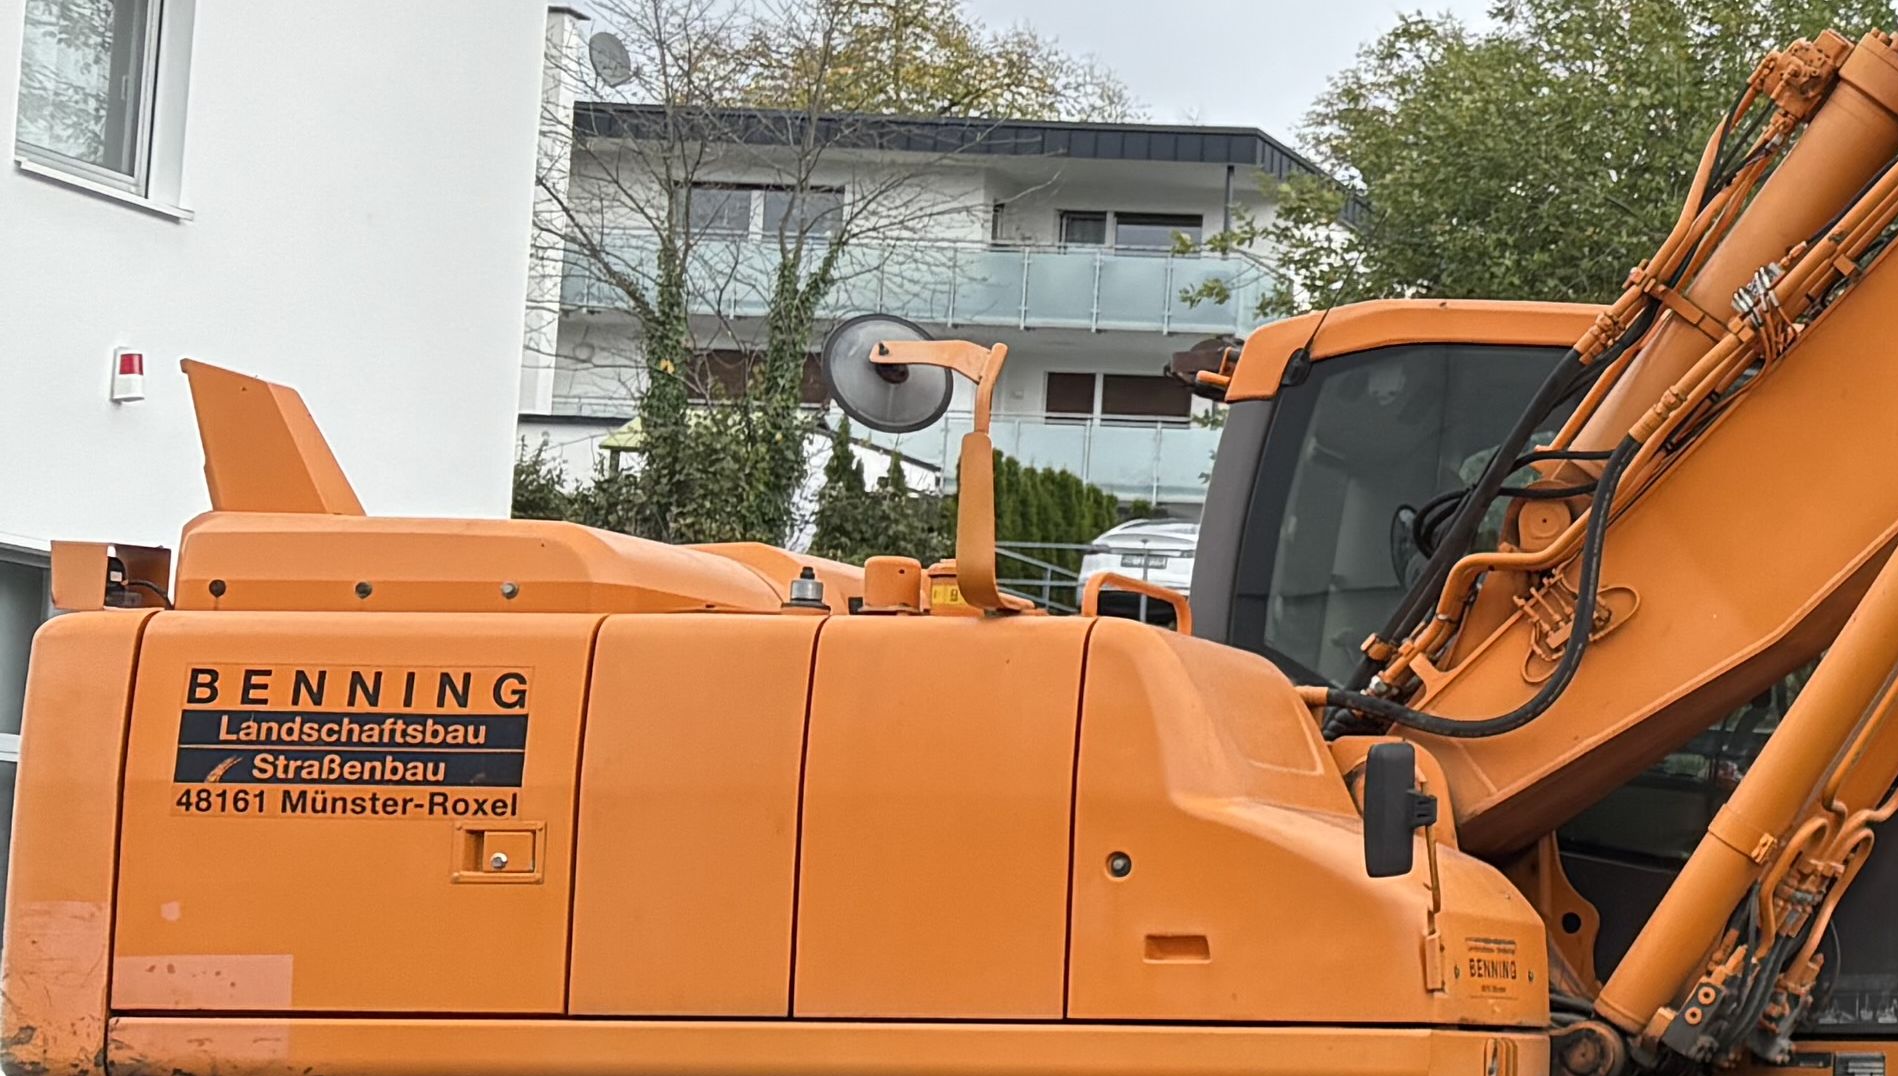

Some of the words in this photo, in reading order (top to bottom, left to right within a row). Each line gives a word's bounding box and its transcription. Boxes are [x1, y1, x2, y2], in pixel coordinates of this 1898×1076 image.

[187, 668, 528, 709] BENNING
[217, 715, 487, 746] Landschaftsbau
[252, 753, 447, 782] Straßenbau
[175, 788, 266, 814] 48161
[280, 788, 519, 817] Münster-Roxel
[1469, 958, 1517, 980] BENNING
